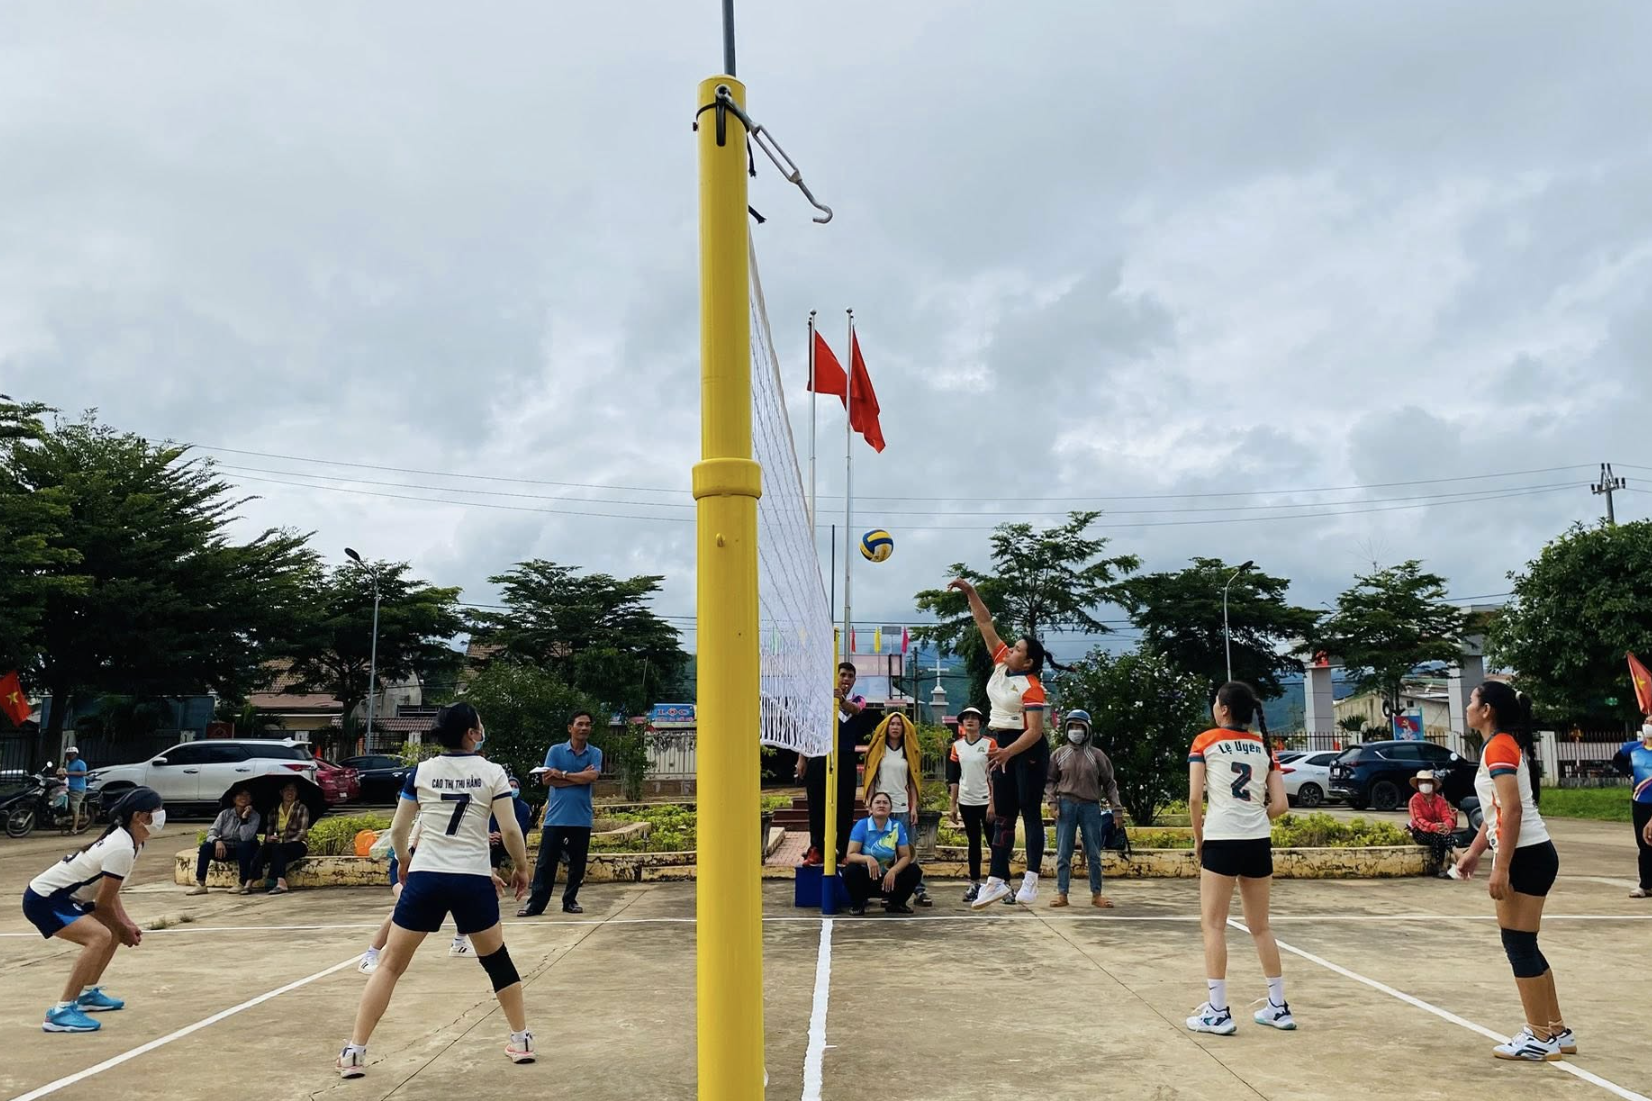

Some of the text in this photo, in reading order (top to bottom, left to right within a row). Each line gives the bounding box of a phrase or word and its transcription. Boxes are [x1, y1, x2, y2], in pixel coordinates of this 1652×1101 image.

[1234, 741, 1261, 755] Uyên
[431, 778, 444, 789] CAO
[455, 779, 465, 789] THU
[1230, 761, 1252, 802] 2
[440, 793, 473, 838] 7
